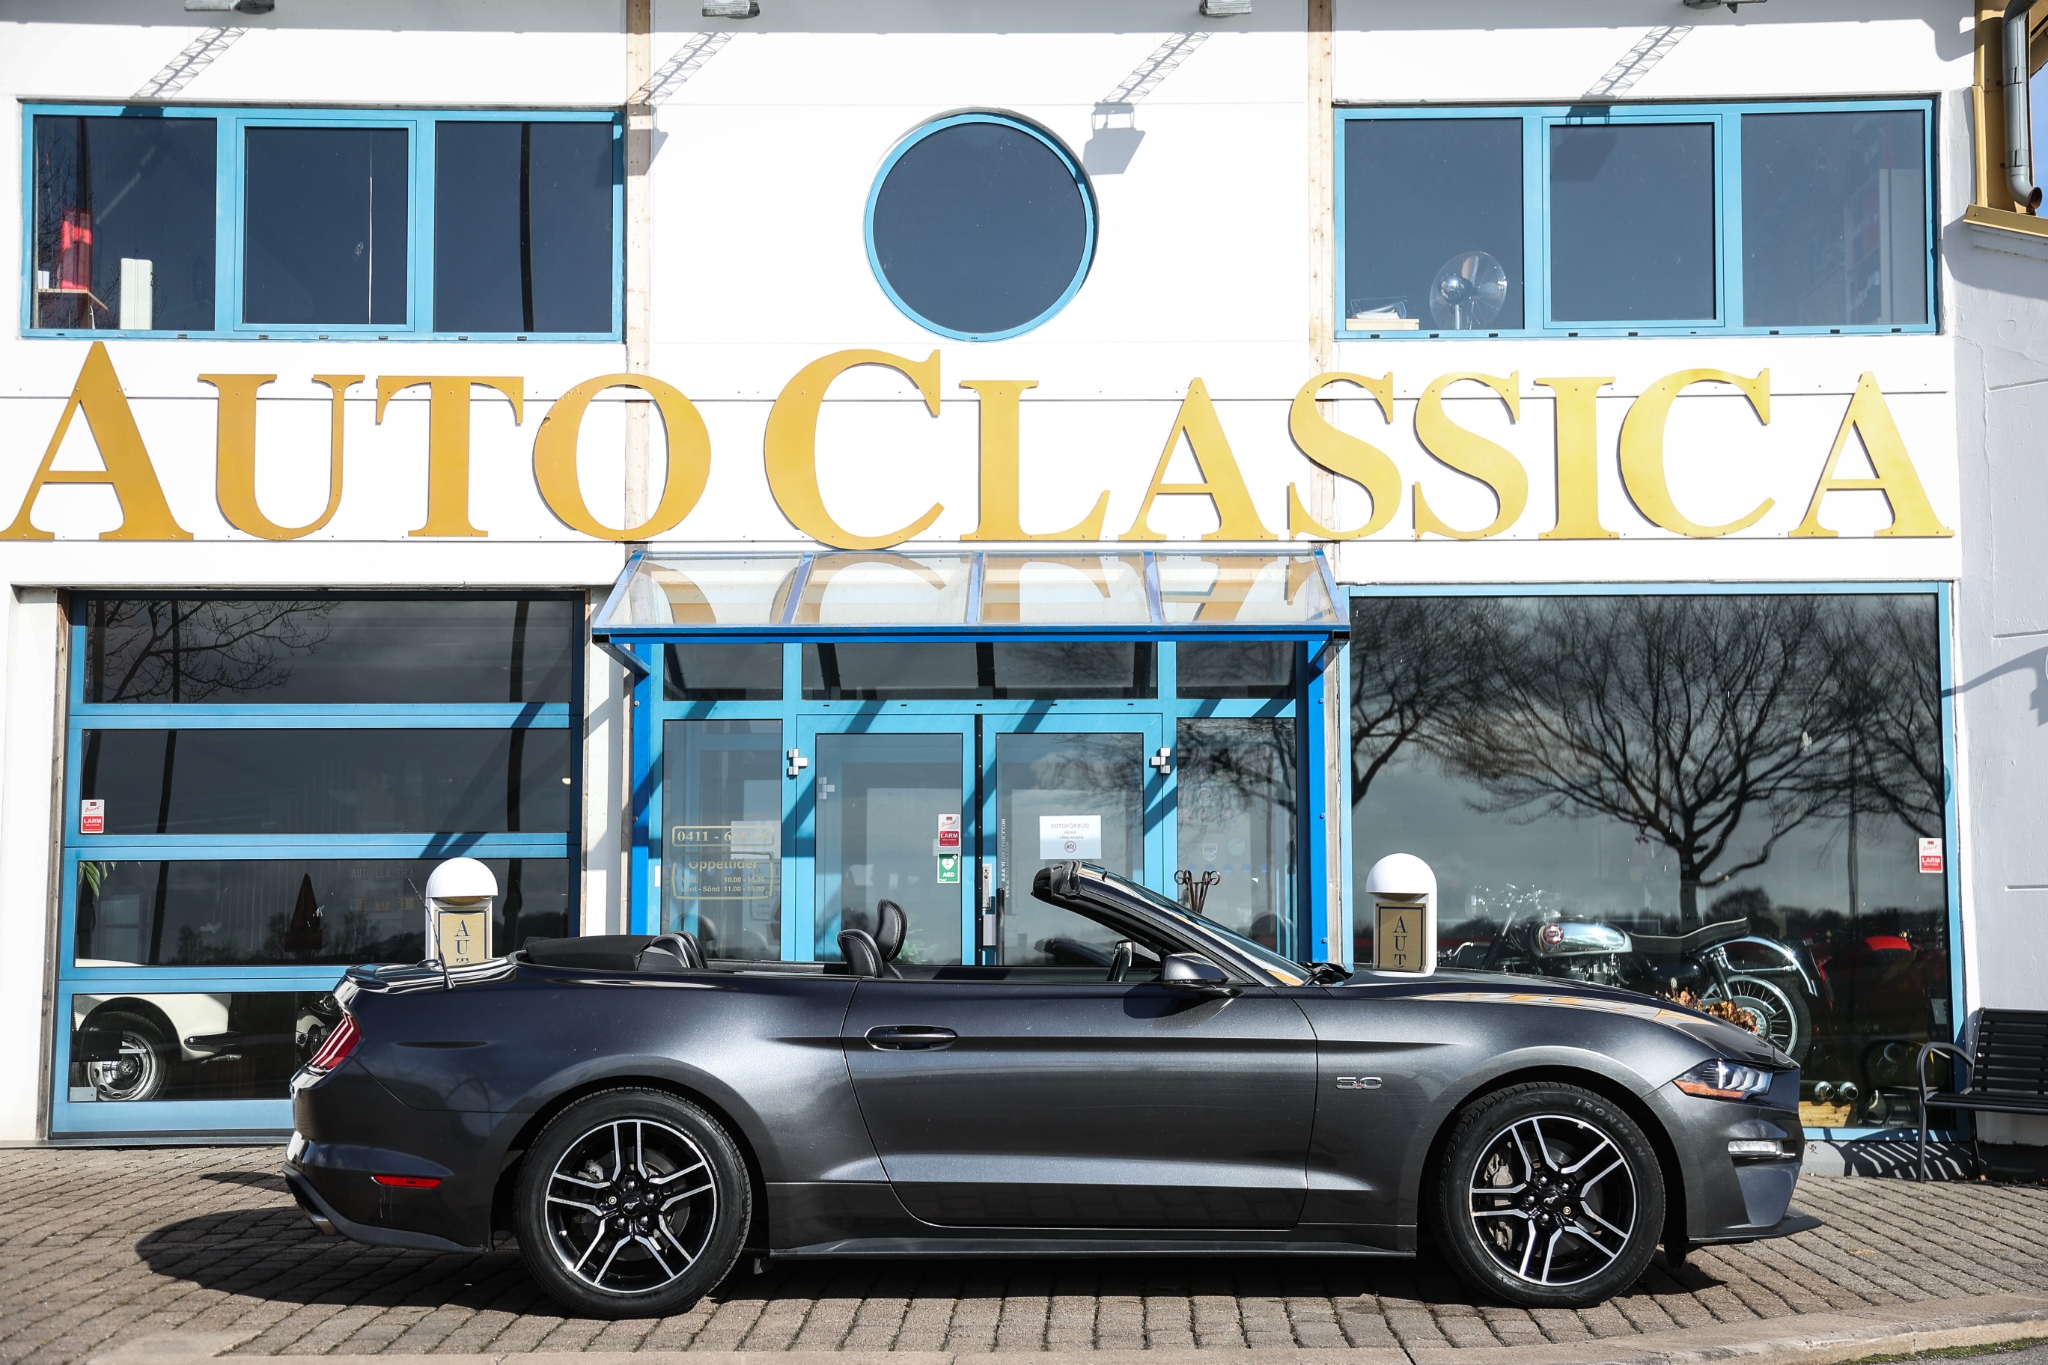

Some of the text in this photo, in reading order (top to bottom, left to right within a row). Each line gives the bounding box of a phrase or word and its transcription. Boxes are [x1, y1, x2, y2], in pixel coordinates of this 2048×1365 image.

[3, 341, 1955, 550] AUTO CLASSICA
[677, 831, 708, 841] 0411
[1336, 1076, 1382, 1090] 5.0
[1576, 1099, 1645, 1157] IRONMAN
